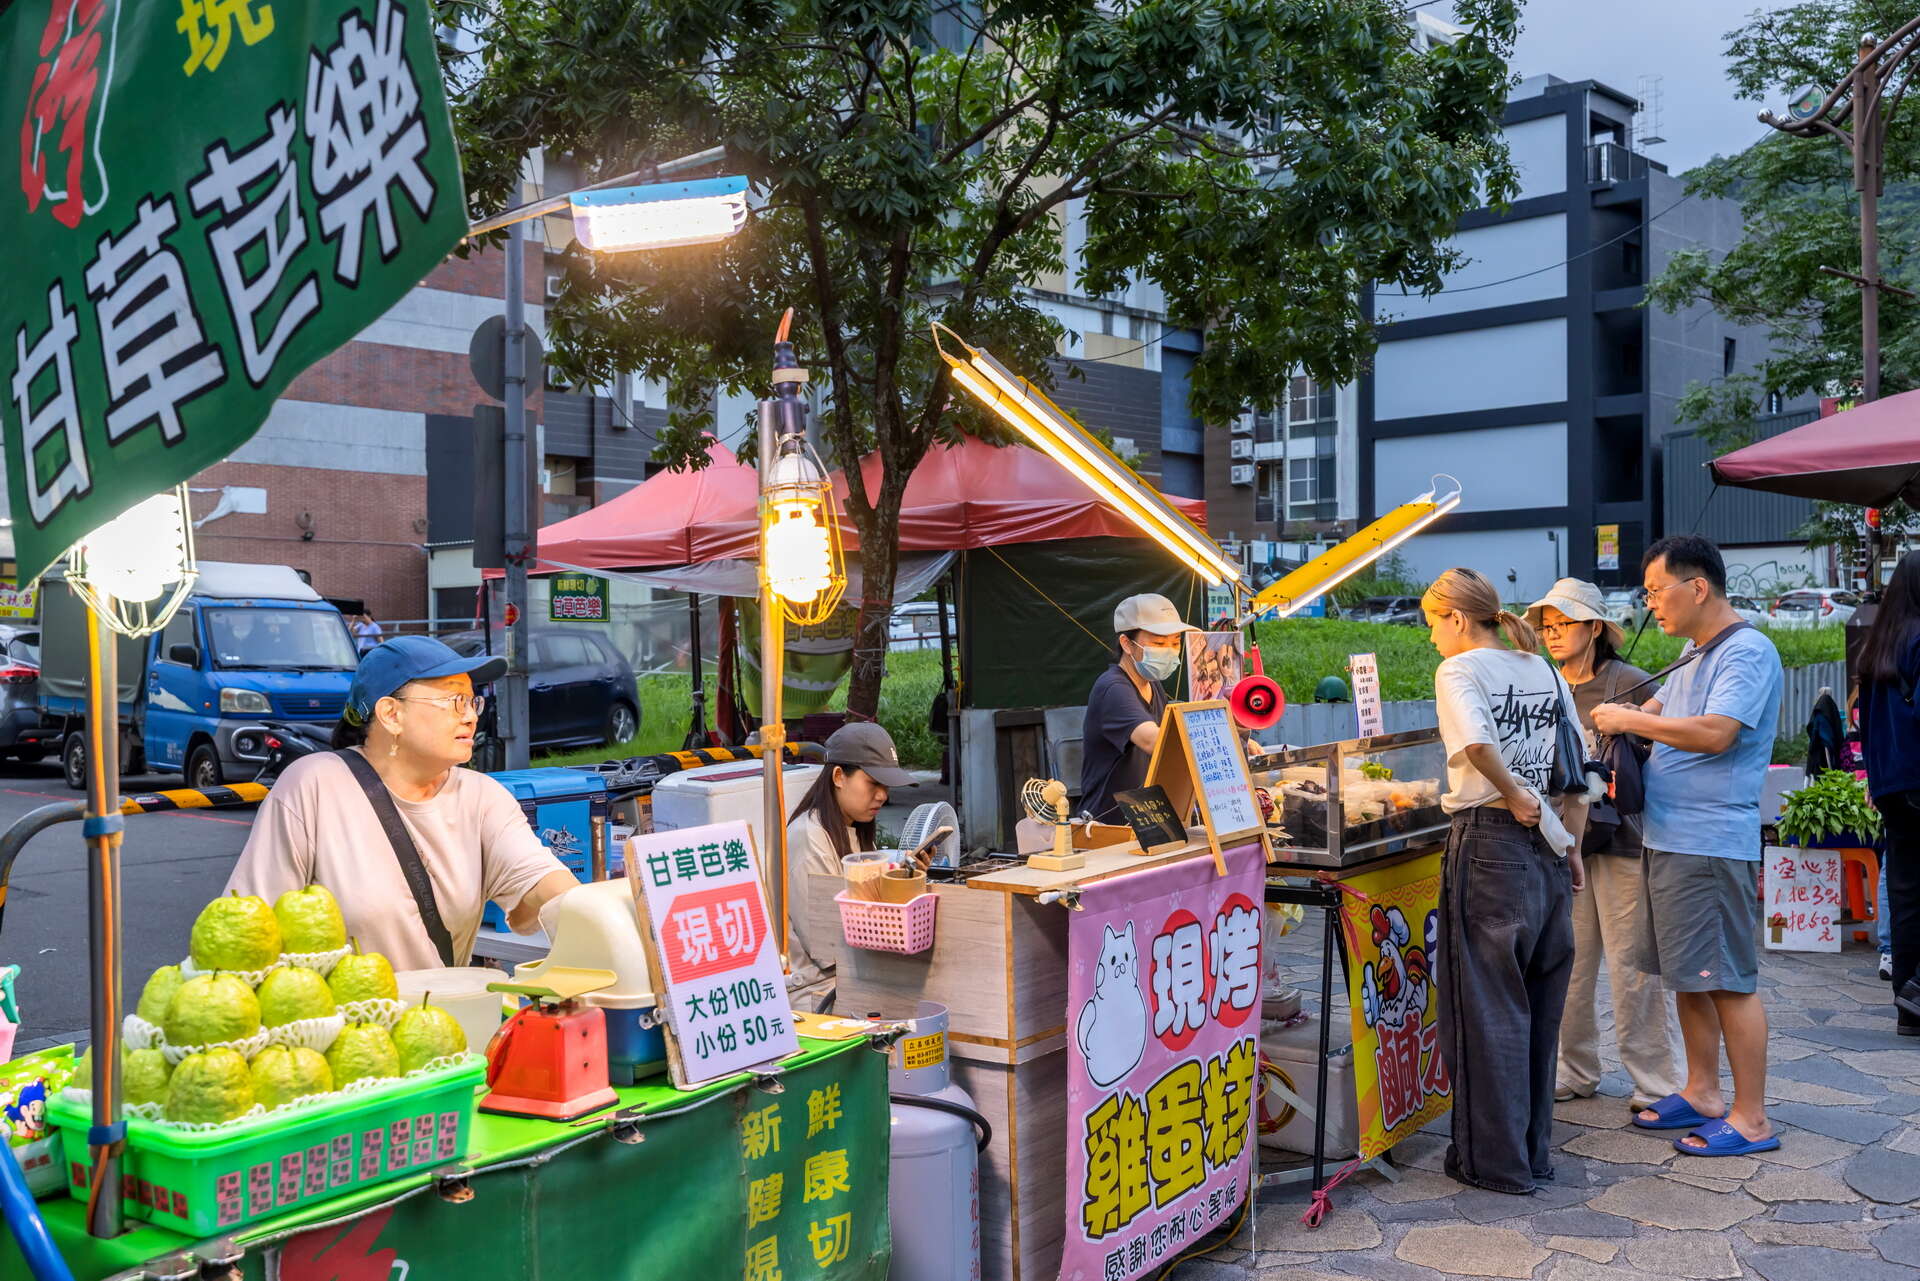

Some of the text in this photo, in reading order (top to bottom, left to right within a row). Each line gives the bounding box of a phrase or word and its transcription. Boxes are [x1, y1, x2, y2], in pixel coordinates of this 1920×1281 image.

[11, 0, 436, 528] 甘草芭樂
[553, 596, 602, 618] 甘草芭樂
[646, 838, 750, 887] 甘草芭樂
[672, 898, 756, 966] 現切
[1152, 904, 1261, 1039] 現烤
[1083, 1037, 1256, 1239] 雞蛋糕
[1104, 1177, 1237, 1281] 感謝您耐心等候
